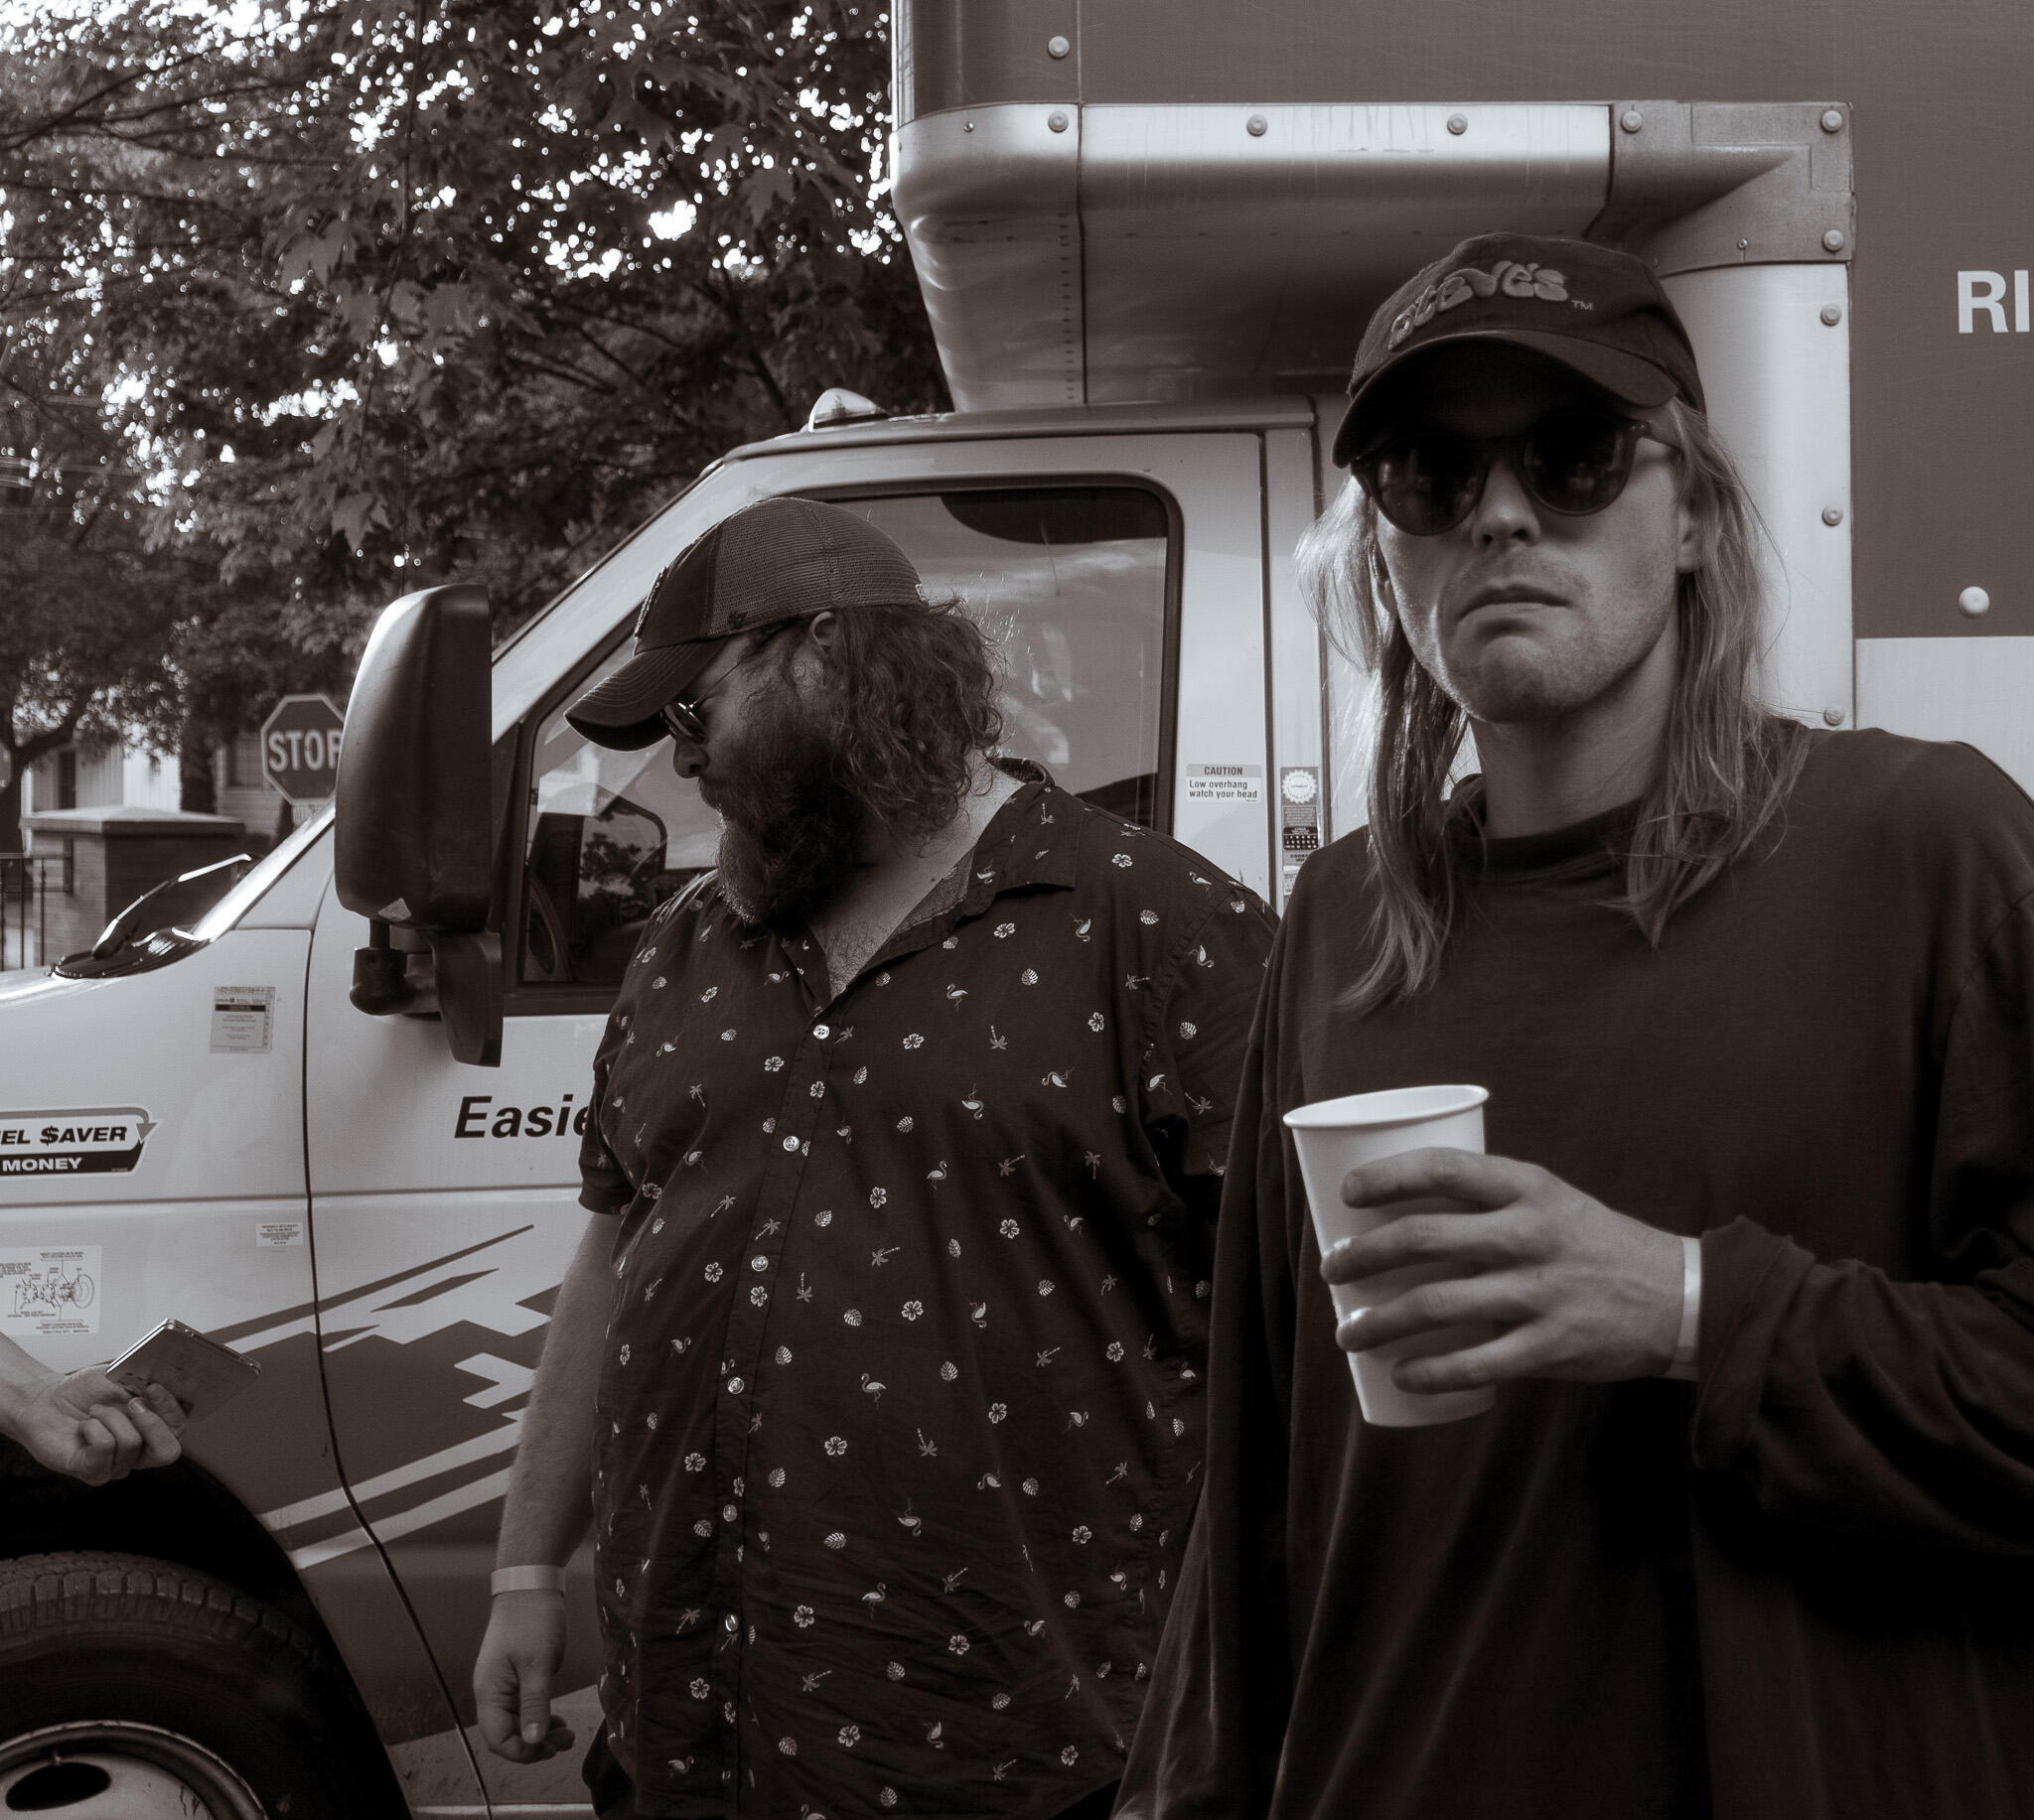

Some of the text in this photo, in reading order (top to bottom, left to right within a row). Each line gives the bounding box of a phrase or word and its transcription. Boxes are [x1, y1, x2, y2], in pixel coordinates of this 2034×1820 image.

[1958, 269, 2030, 334] RI
[268, 729, 344, 771] STOP
[1204, 767, 1243, 775] CAUTION
[1189, 779, 1247, 789] Low overhang
[1189, 789, 1214, 798] watch
[1236, 789, 1257, 798] head
[0, 1124, 128, 1147] EL $AVER
[2, 1157, 83, 1173] MONEY
